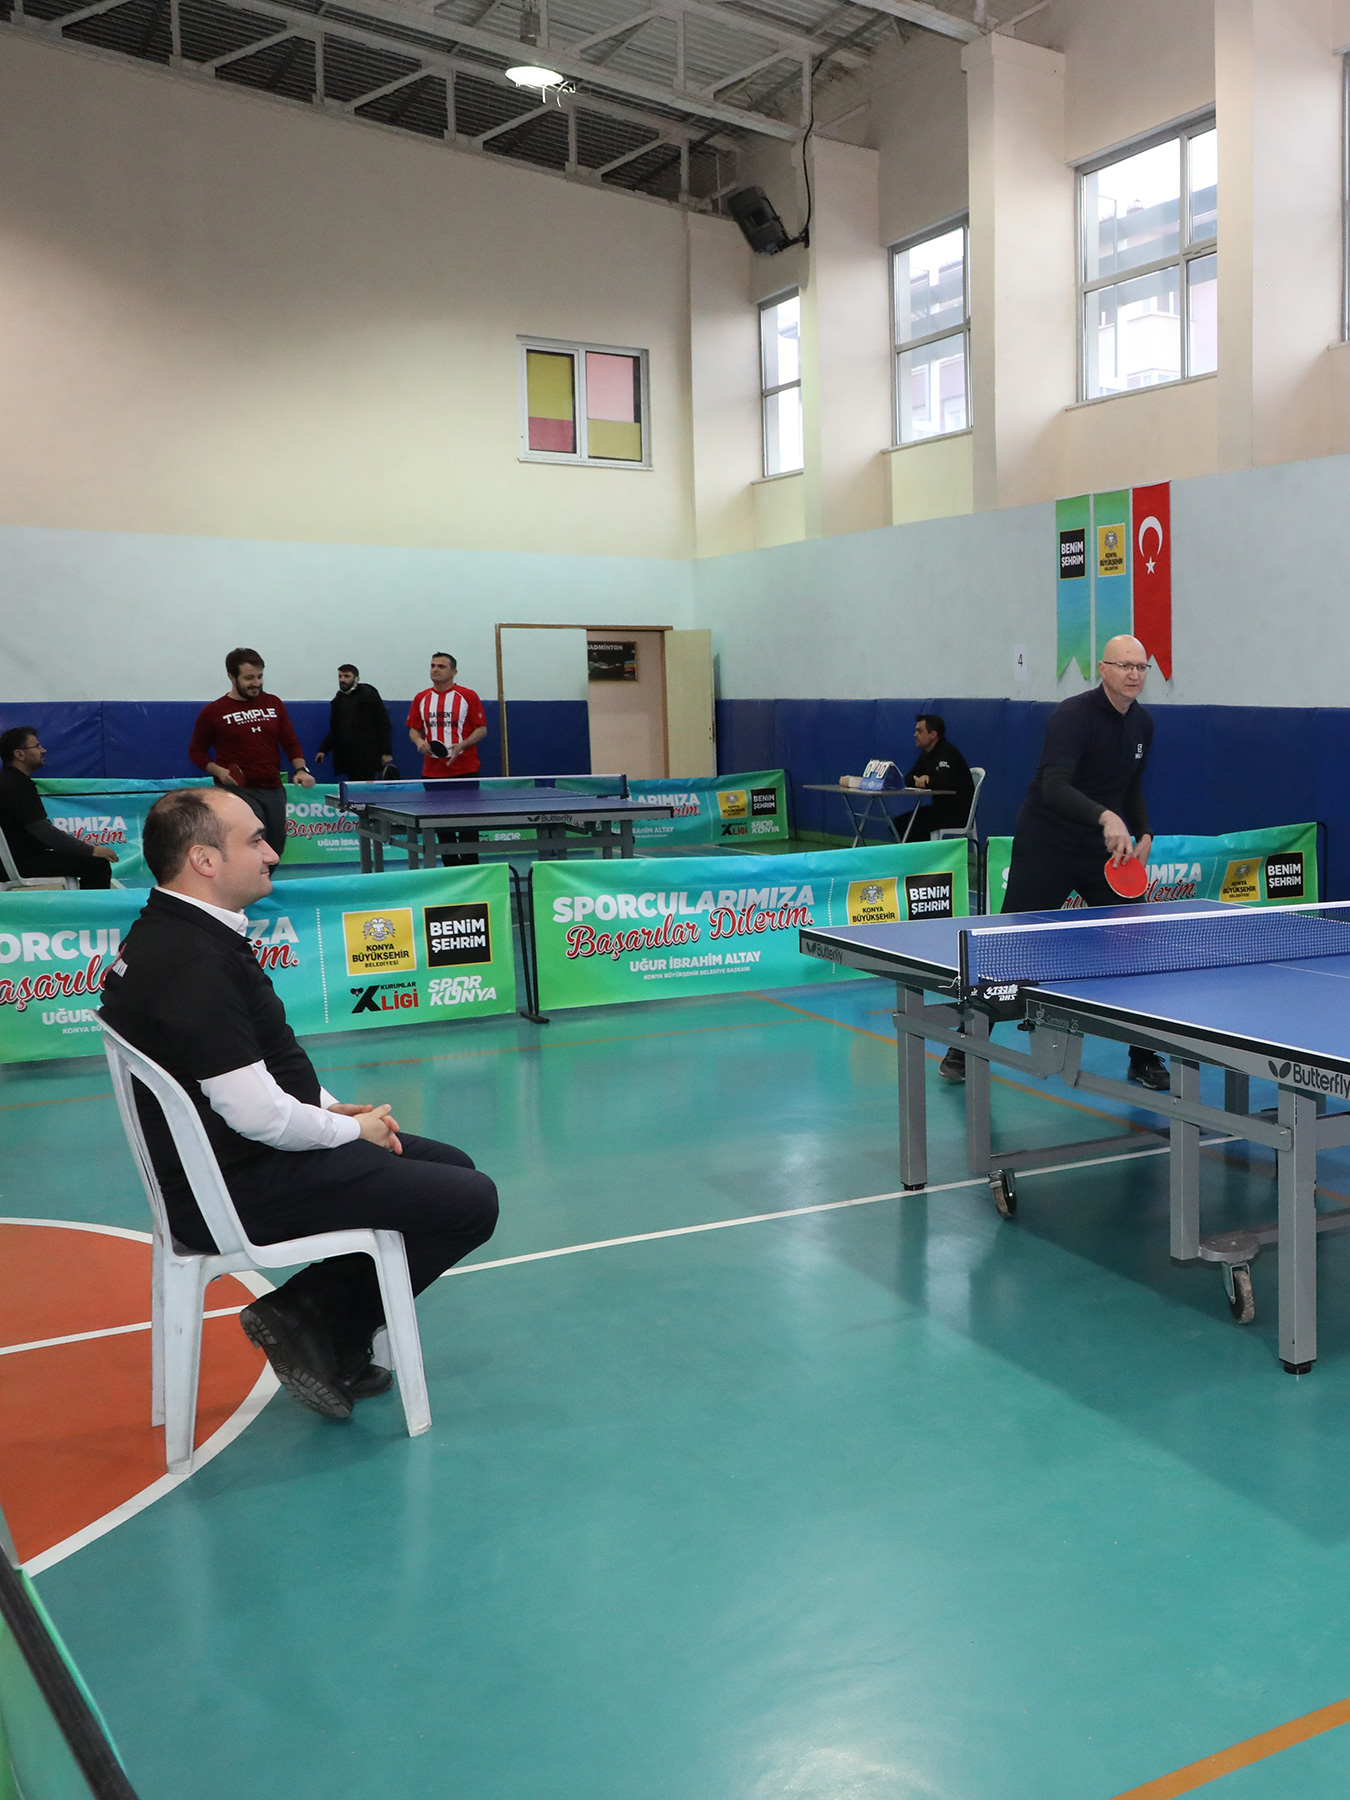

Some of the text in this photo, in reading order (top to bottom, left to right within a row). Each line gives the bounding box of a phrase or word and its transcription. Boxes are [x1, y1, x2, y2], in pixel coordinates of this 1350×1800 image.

[1018, 653, 1023, 667] 4
[223, 708, 277, 725] TEMPLE
[341, 837, 360, 846] İBRA
[552, 884, 815, 923] SPORCULARIMIZA
[862, 906, 884, 914] KONYA
[566, 902, 815, 960] Başarılar Dilerim.
[366, 943, 395, 952] KONYA
[816, 943, 843, 964] Butterfly
[352, 950, 410, 963] BÜYÜKŞEHİR
[629, 951, 761, 972] UĞUR İBRAHİM ALTAY
[380, 981, 416, 990] KURUMLAR
[427, 975, 482, 993] SPOR
[430, 985, 497, 1007] KONYA
[62, 1026, 89, 1034] KONYA
